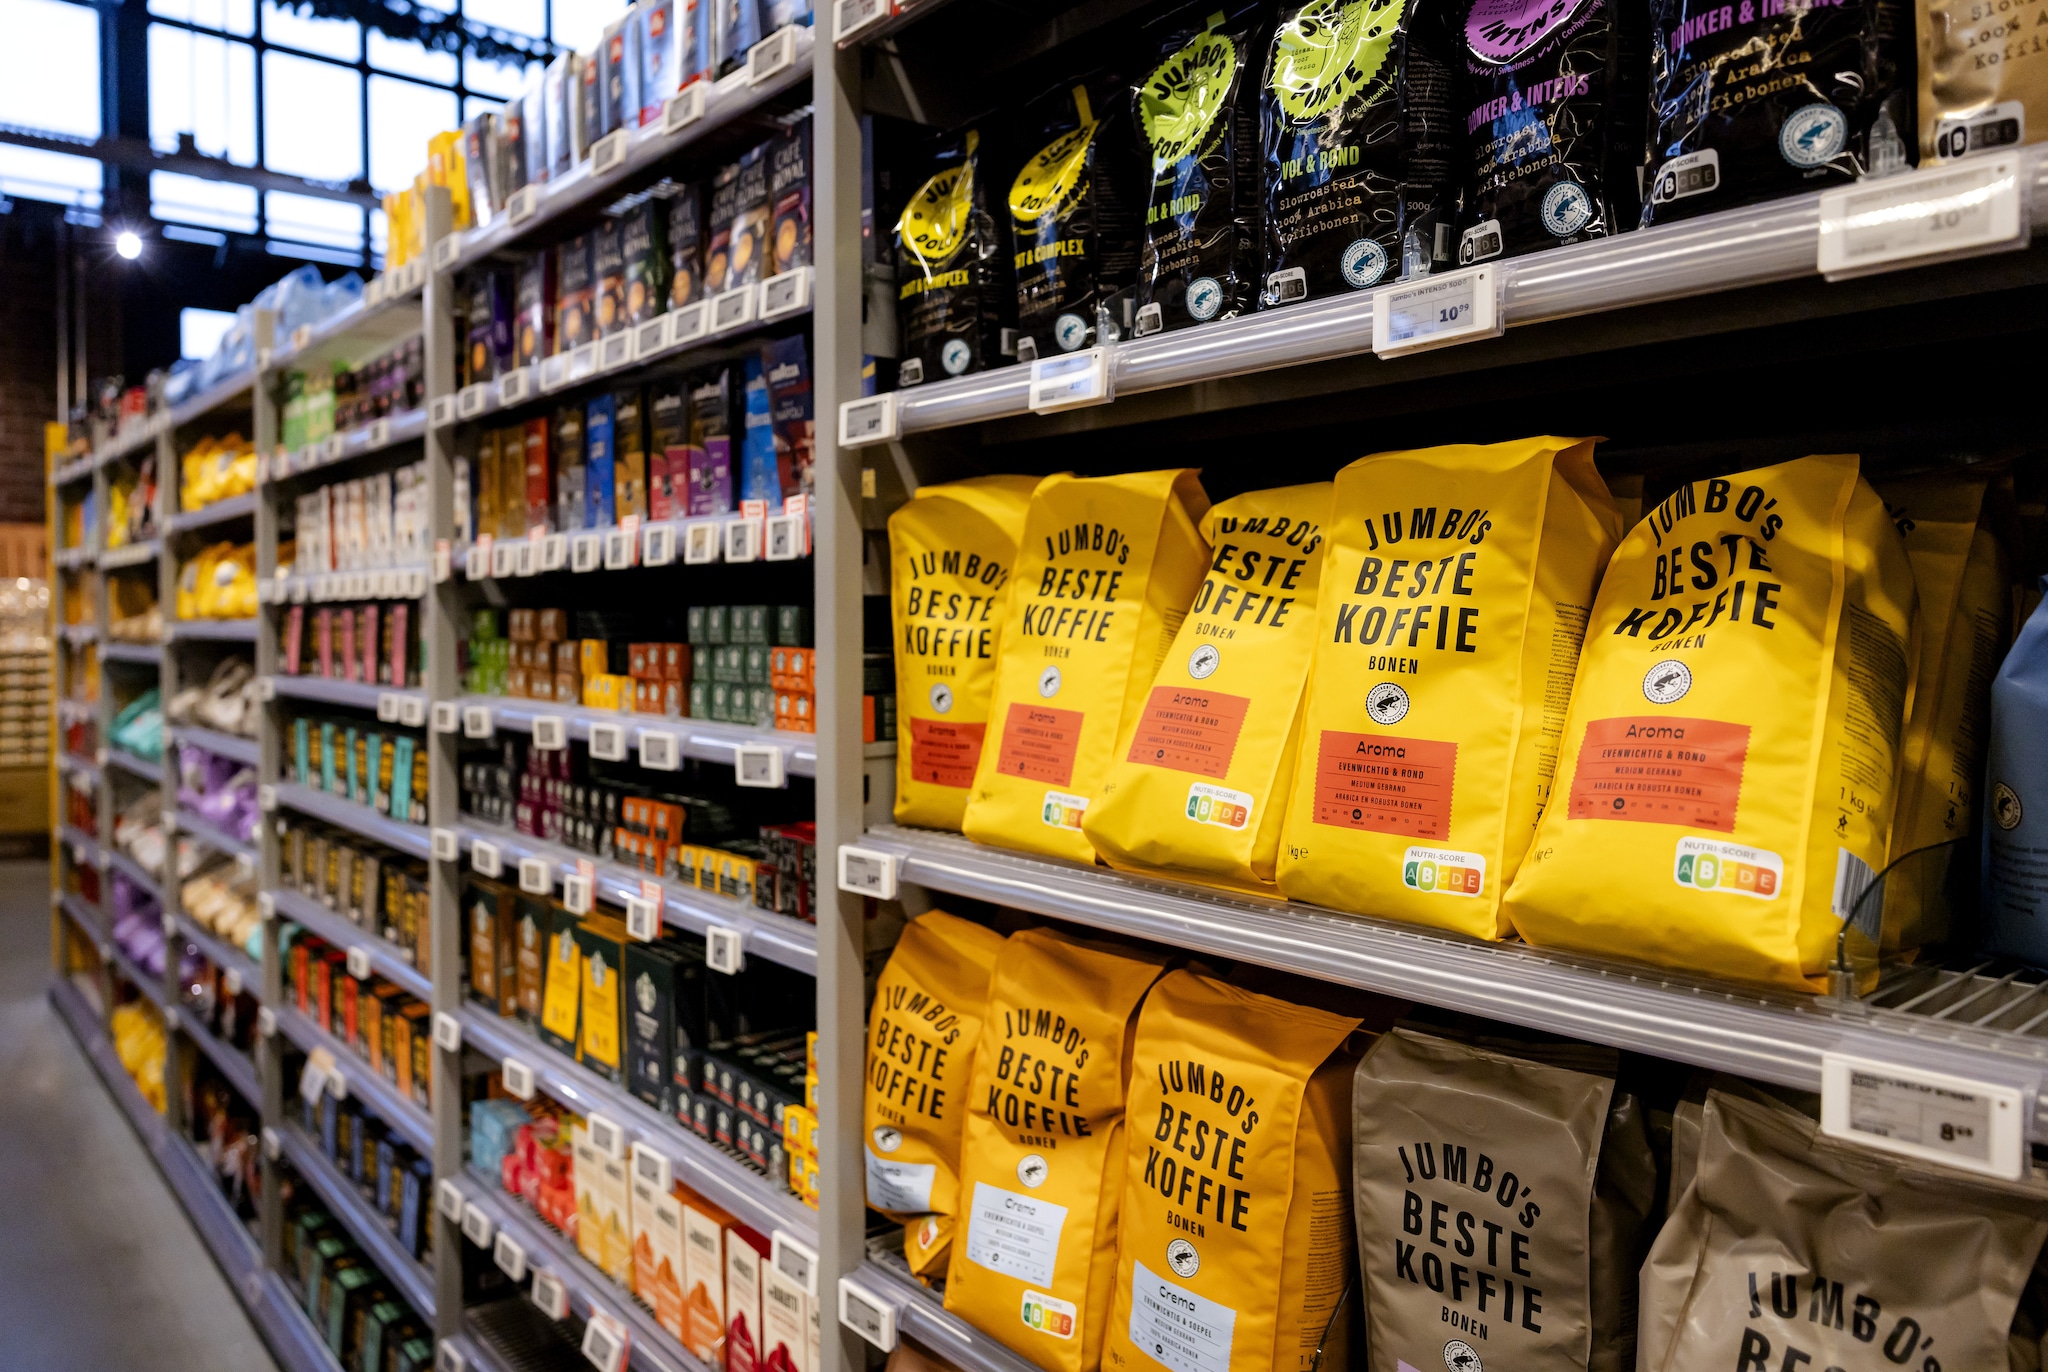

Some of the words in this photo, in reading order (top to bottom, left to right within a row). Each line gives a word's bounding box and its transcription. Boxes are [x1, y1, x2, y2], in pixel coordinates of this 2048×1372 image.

[1479, 0, 1566, 47] INTENS
[1670, 5, 1733, 55] DONKER
[1738, 0, 1755, 25] &
[1968, 15, 2021, 48] 100%
[1468, 95, 1507, 135] DONKER
[1510, 91, 1521, 112] &
[1526, 73, 1589, 107] INTENS
[1282, 154, 1303, 181] VOL
[1306, 153, 1316, 173] &
[1320, 145, 1359, 172] ROND
[1160, 202, 1168, 219] &
[1169, 194, 1200, 217] ROND
[1280, 178, 1356, 211] Slowroasted
[1407, 201, 1430, 213] 500g
[1279, 207, 1302, 229] 100%
[1307, 195, 1362, 218] Arabica
[1280, 213, 1359, 245] Koffiebonen
[1161, 238, 1201, 260] Arabica
[1391, 291, 1417, 302] Jumbo's
[1417, 284, 1447, 296] INTENSO
[1364, 507, 1492, 551] JUMBO's
[1648, 479, 1783, 549] JUMBO's
[1046, 523, 1130, 565] JUMBO's
[1213, 517, 1322, 555] UMBO's
[1212, 543, 1306, 590] ESTE
[1354, 552, 1477, 599] BESTE
[1651, 534, 1772, 600] BESTE
[1038, 567, 1123, 602] BESTE
[908, 587, 997, 622] BESTE
[1193, 579, 1295, 628] OFFIE
[1613, 580, 1781, 640] KOFFIE
[1024, 604, 1114, 642] KOFFIE
[1195, 622, 1236, 640] BONEN
[1334, 603, 1479, 653] KOFFIE
[905, 624, 992, 659] KOFFIE
[1044, 645, 1071, 659] BONEN
[1650, 634, 1706, 652] BONEN
[927, 665, 956, 677] BONEN
[1368, 656, 1418, 675] BONEN
[1172, 693, 1209, 708] Aroma
[1156, 710, 1193, 722] EVENWICHTIG
[1201, 716, 1219, 727] ROND
[1626, 724, 1685, 739] Aroma
[1356, 741, 1406, 759] Aroma
[1602, 749, 1662, 760] EVENWICHTIG
[1666, 751, 1673, 760] &
[1678, 751, 1706, 763] ROND
[1338, 762, 1389, 776] EVENWICHTIG
[1392, 768, 1398, 777] &
[1402, 769, 1424, 780] ROND
[1351, 779, 1375, 790] MEDIUM
[1377, 782, 1406, 793] GEBRAND
[1615, 765, 1644, 775] MEDIUM
[1646, 767, 1682, 777] GEBRAND
[1194, 785, 1238, 800] NUTRI-SCORE
[1335, 792, 1359, 803] ARABICA
[1361, 795, 1369, 804] EN
[1371, 796, 1398, 807] ROBUSTA
[1400, 799, 1423, 810] BONEN
[1594, 782, 1623, 791] ARABICA
[1625, 782, 1635, 791] EN
[1637, 783, 1671, 793] ROBUSTA
[1674, 786, 1703, 797] BONEN
[1410, 850, 1466, 863] NUTRI-SCORE
[1684, 841, 1757, 860] NUTRI-SCORE
[885, 985, 960, 1045] JUMBO's
[877, 1017, 948, 1082] BESTE
[1006, 1008, 1089, 1070] JUMBO's
[870, 1050, 945, 1119] KOFFIE
[997, 1045, 1080, 1108] BESTE
[987, 1084, 1093, 1138] KOFFIE
[1158, 1060, 1258, 1134] JUMBO's
[1018, 1134, 1056, 1150] BONEN
[1155, 1101, 1246, 1181] BESTE
[1144, 1145, 1250, 1232] KOFFIE
[1398, 1142, 1540, 1229] JUMBO's
[1005, 1198, 1036, 1216] Crema
[1166, 1210, 1205, 1238] BONEN
[1403, 1189, 1531, 1278] BESTE
[1158, 1285, 1196, 1312] Crema
[1396, 1238, 1542, 1334] KOFFIE
[1144, 1295, 1180, 1322] EVENWICHTIG
[1182, 1317, 1187, 1325] &
[1189, 1320, 1212, 1338] SOEPEL
[1154, 1317, 1172, 1332] MEDIUM
[1173, 1327, 1195, 1344] GEBRAND
[1442, 1306, 1488, 1340] BONEN
[1748, 1272, 1940, 1372] JUMBO's
[1162, 1334, 1181, 1350] ARABICA
[1182, 1346, 1199, 1359] BONEN
